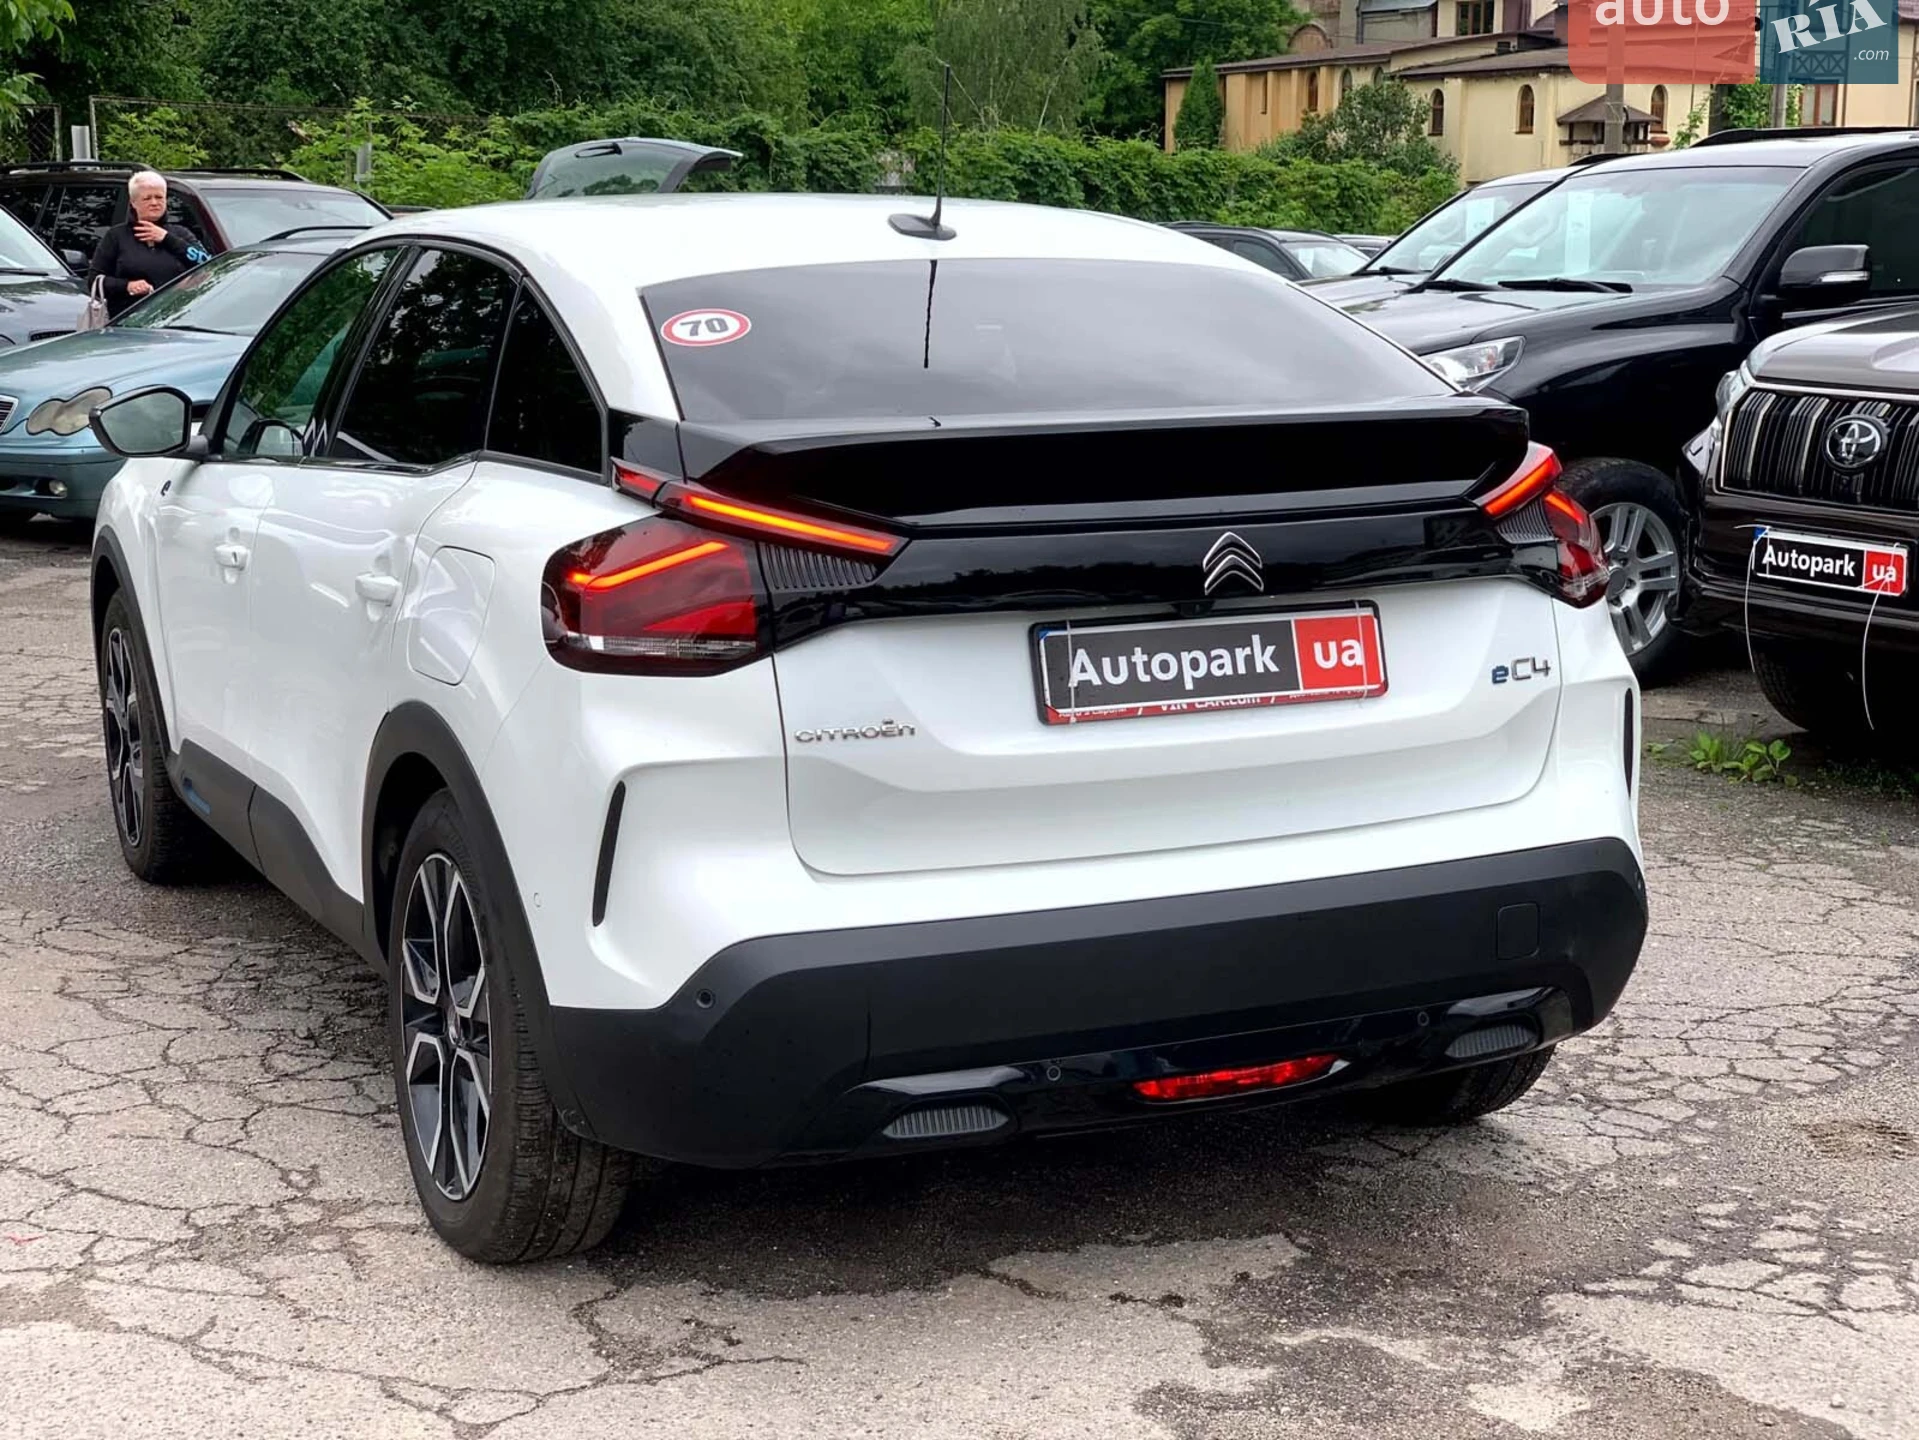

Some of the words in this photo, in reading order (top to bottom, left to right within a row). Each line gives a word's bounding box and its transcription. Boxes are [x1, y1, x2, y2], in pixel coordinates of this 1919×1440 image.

[680, 317, 729, 337] 70
[1761, 544, 1855, 578] Autopark
[1872, 563, 1897, 582] ua
[1068, 634, 1280, 690] Autopark
[1313, 637, 1365, 670] ua
[1491, 656, 1551, 685] eC4
